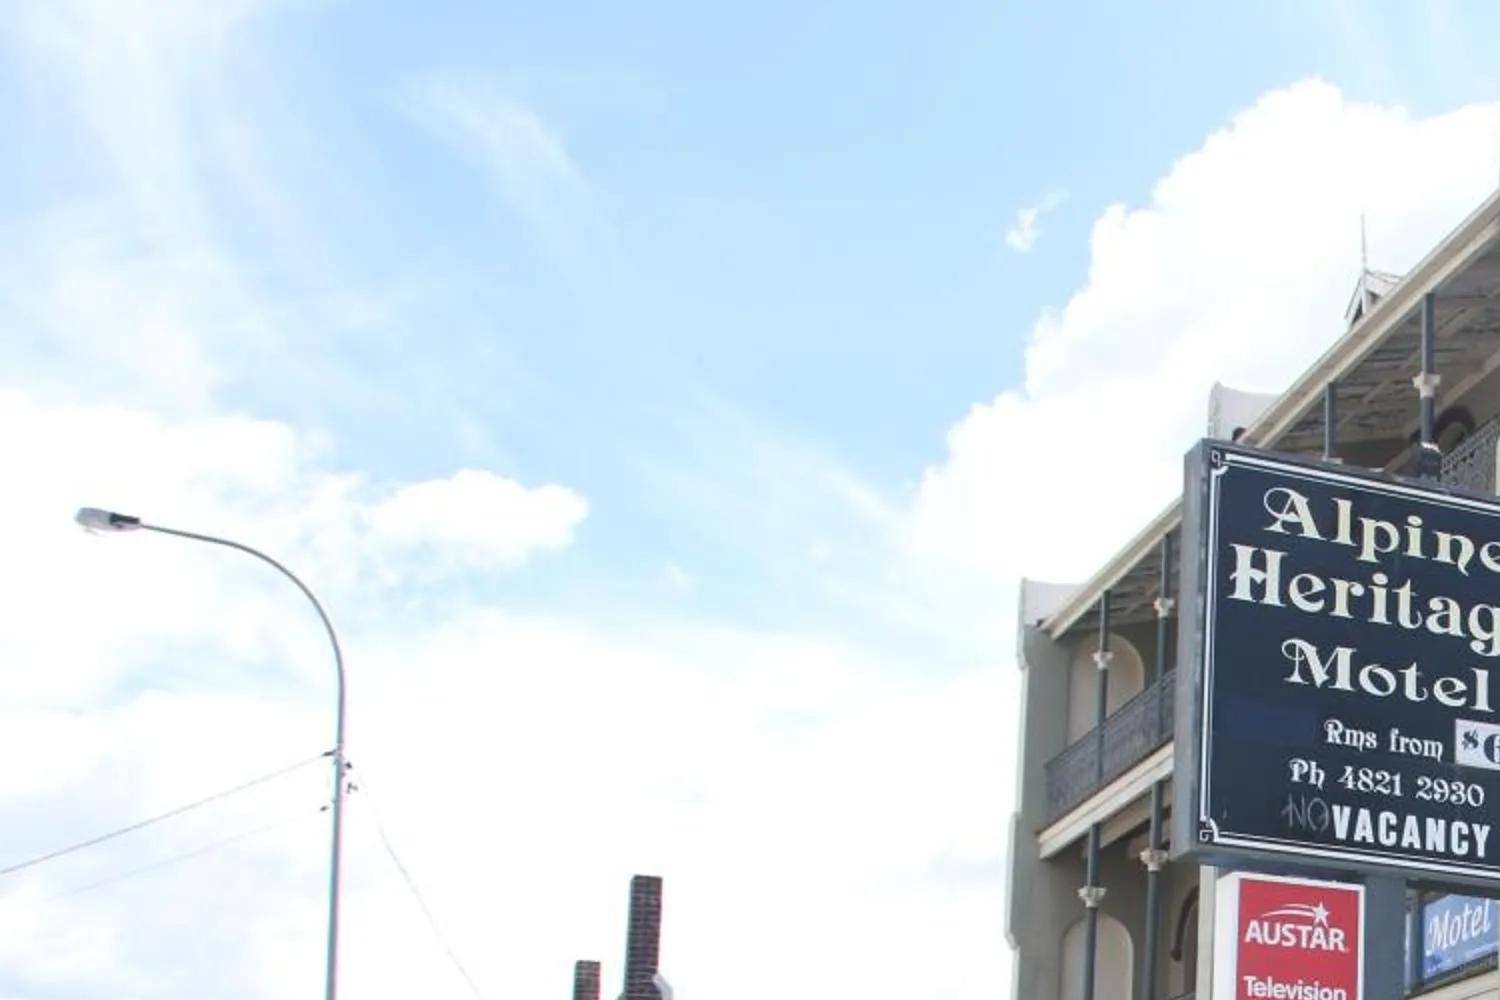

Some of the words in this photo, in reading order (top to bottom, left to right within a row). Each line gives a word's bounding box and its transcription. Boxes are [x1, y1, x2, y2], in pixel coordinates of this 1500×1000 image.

[1281, 638, 1495, 713] Motel
[1324, 719, 1378, 754] Rms
[1390, 728, 1444, 762] from
[1289, 758, 1326, 790] Ph
[1337, 765, 1404, 797] 4821
[1415, 776, 1485, 807] 2930
[1331, 804, 1491, 858] VACANCY
[1244, 920, 1346, 952] AUSTAR
[1426, 898, 1491, 955] Motel
